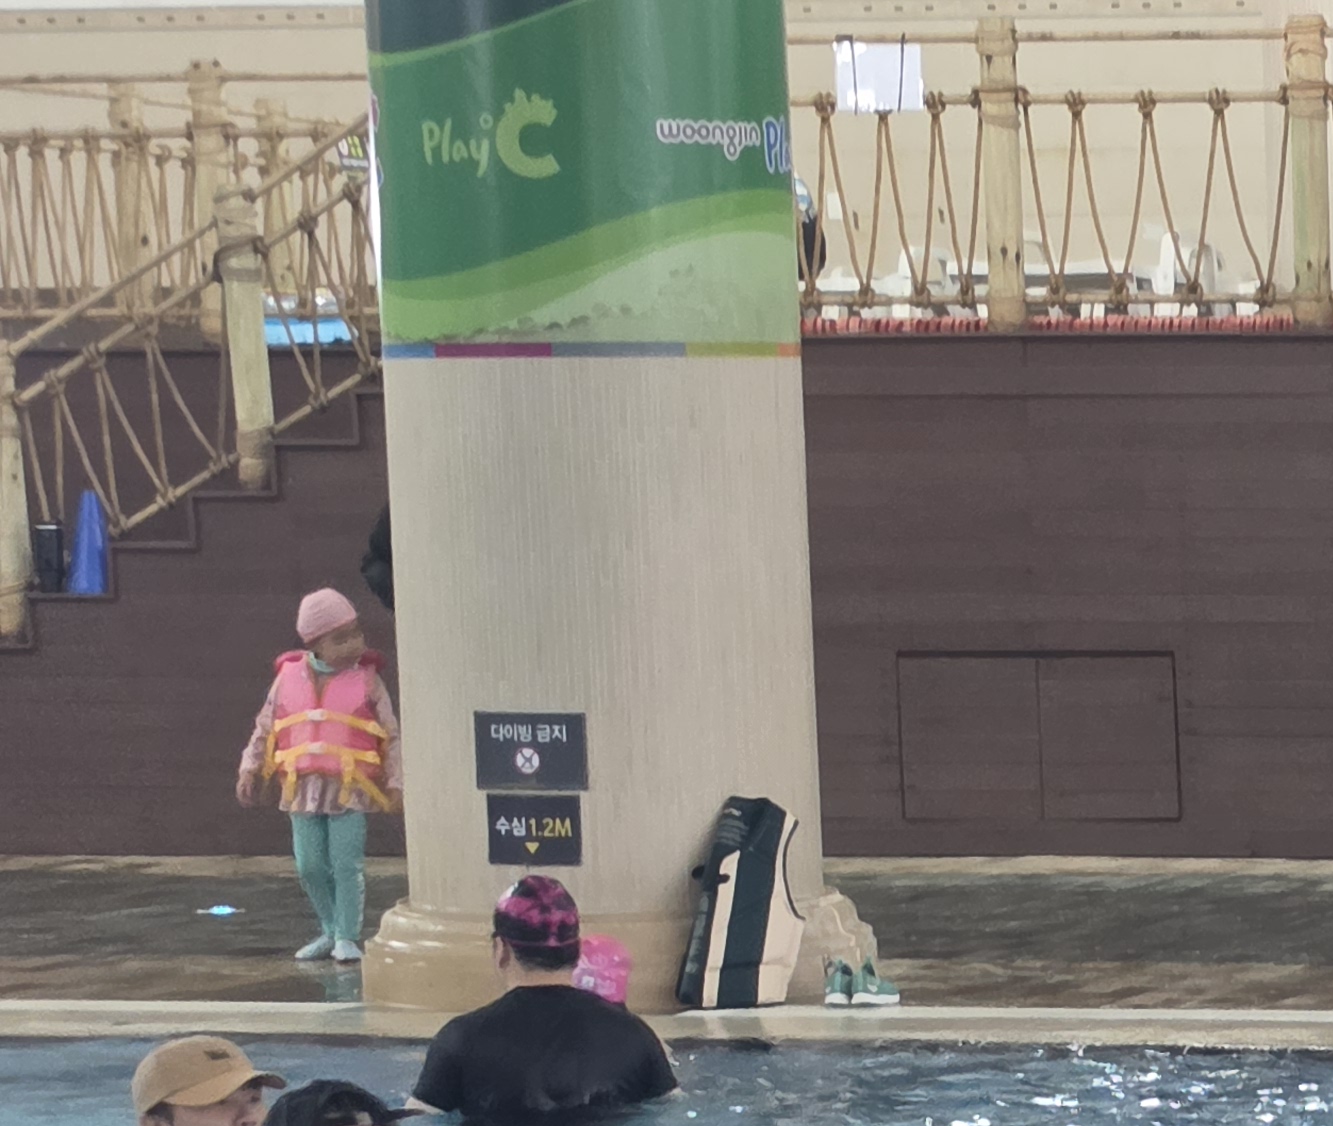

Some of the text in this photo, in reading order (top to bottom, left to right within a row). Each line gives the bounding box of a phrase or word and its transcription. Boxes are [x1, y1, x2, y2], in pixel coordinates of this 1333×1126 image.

[490, 723, 567, 743] 다이빙 금지
[495, 815, 573, 838] 수심 1.2M
